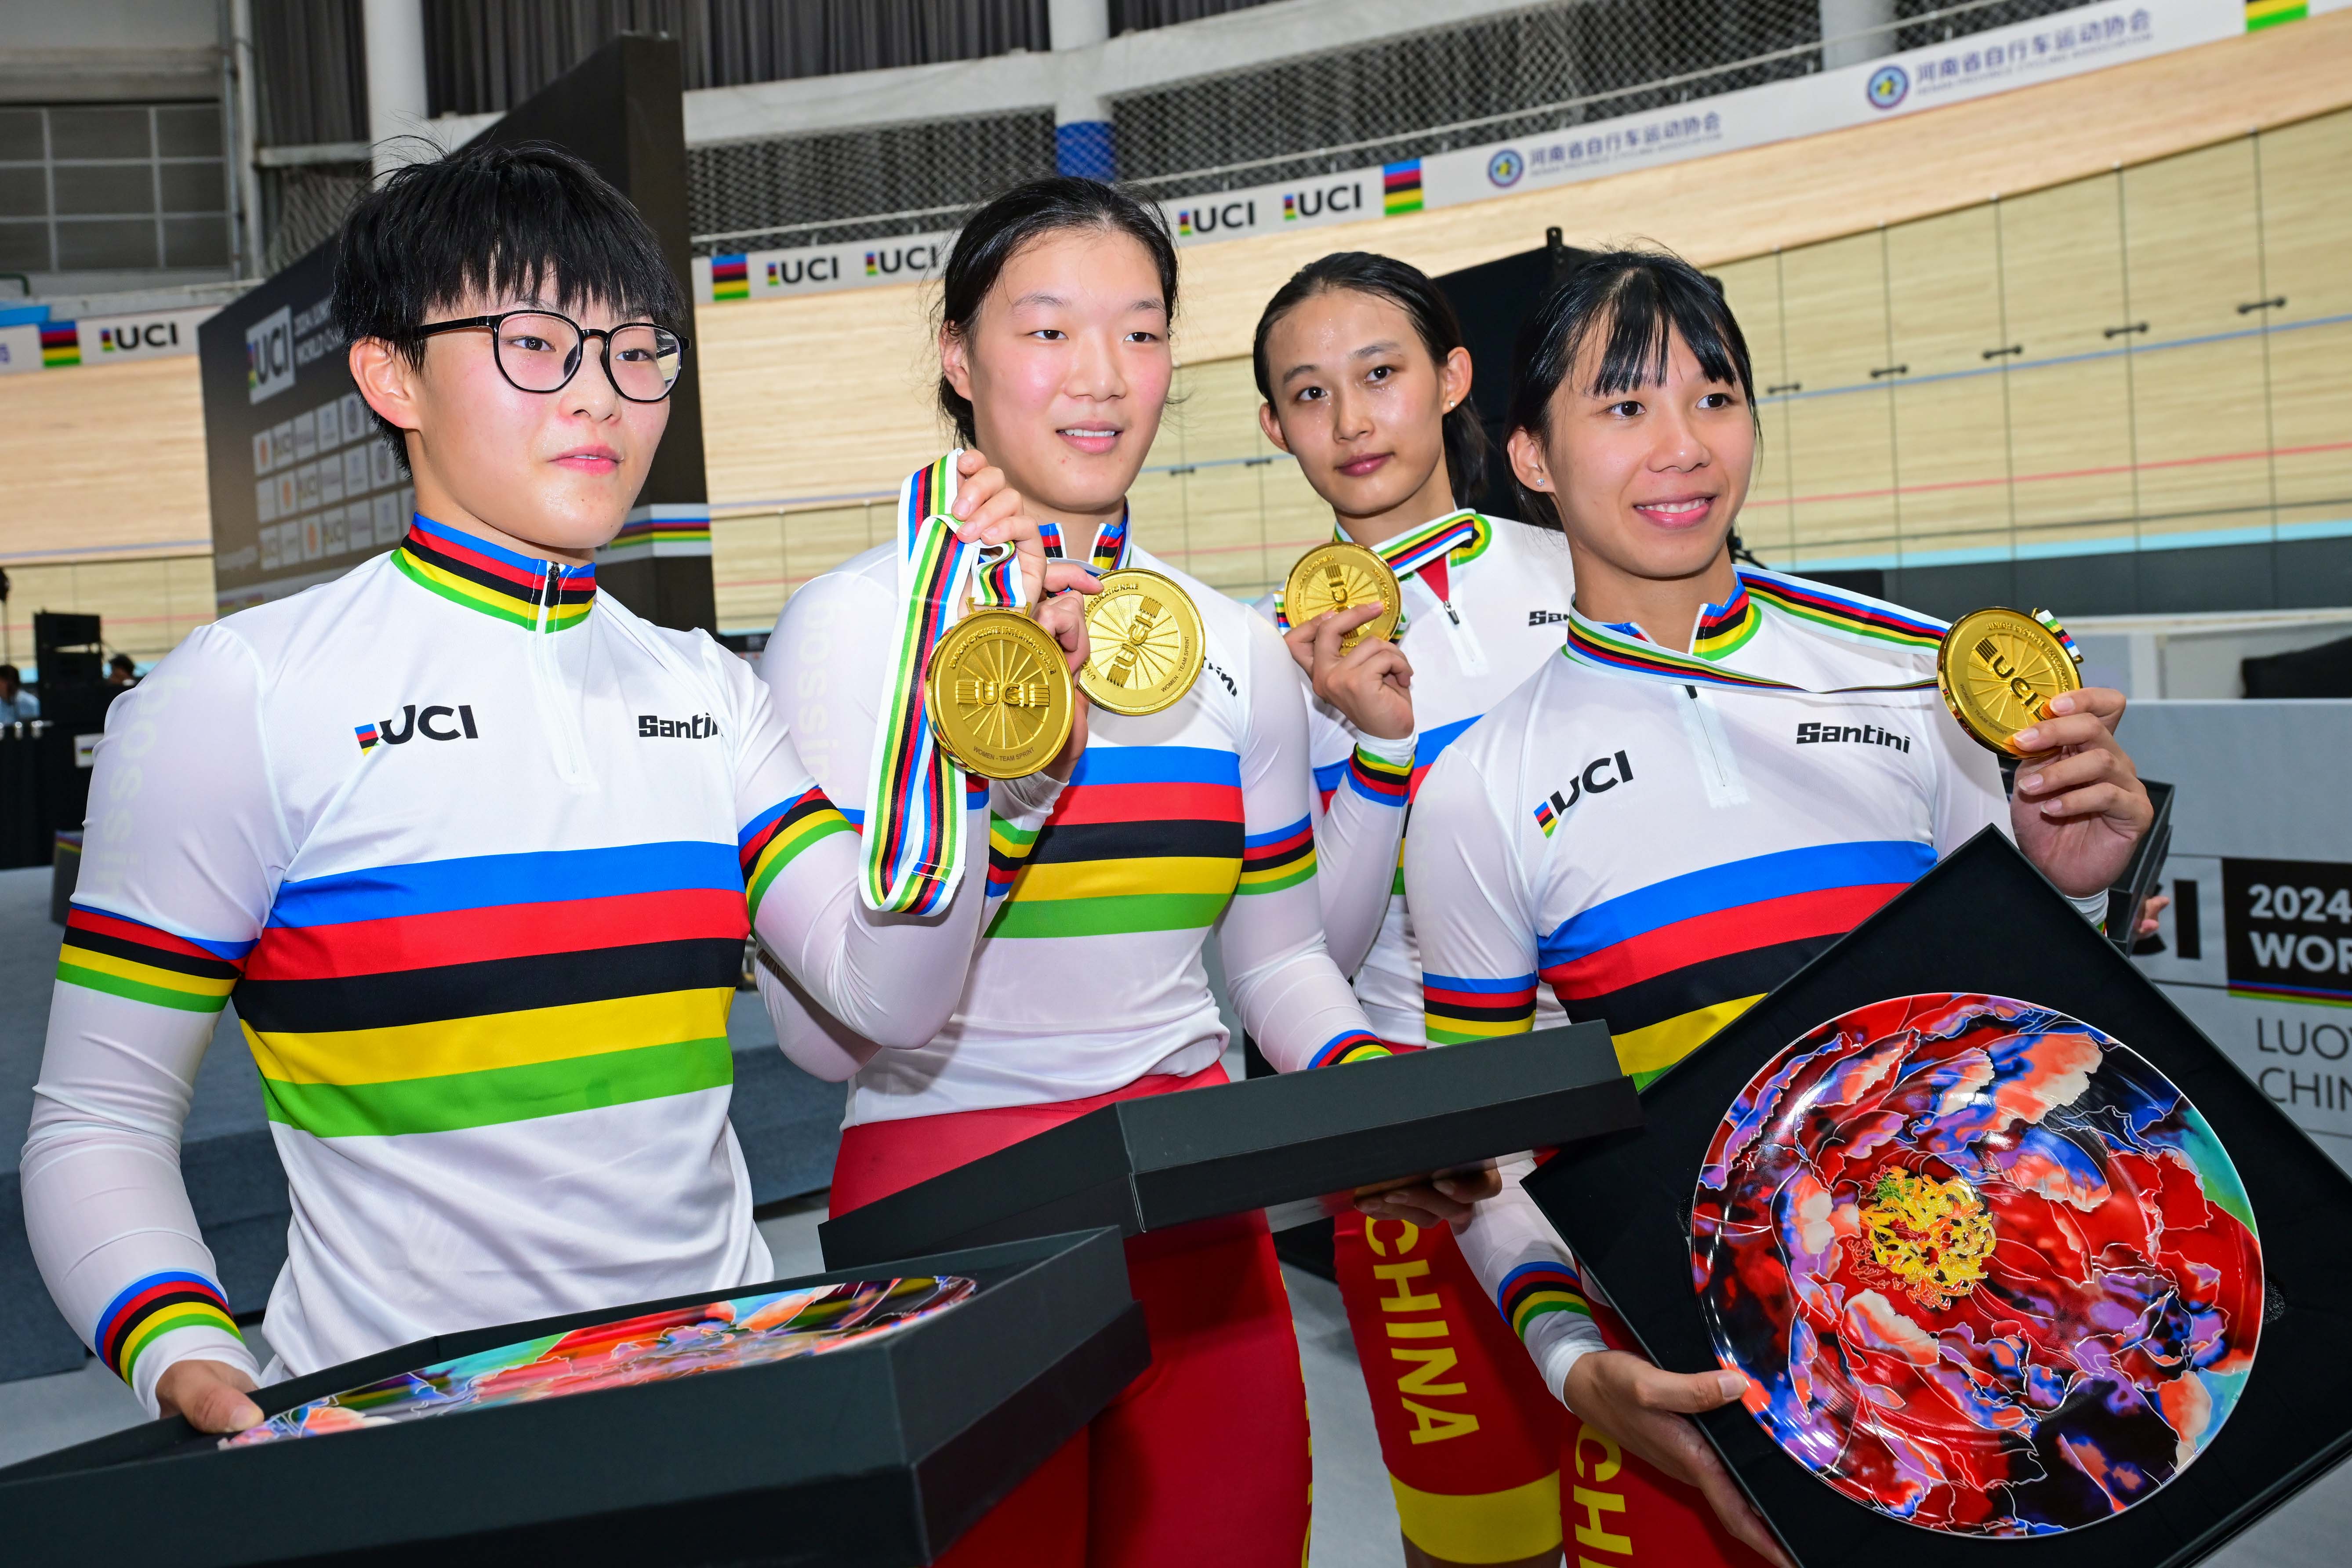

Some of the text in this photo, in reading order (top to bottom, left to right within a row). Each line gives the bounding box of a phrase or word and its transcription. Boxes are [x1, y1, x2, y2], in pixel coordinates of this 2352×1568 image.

[1916, 8, 2151, 83] 河南省自行车运动协会
[1530, 111, 1720, 166] 河南省自行车运动协会
[1193, 200, 1255, 232] UCI
[1299, 183, 1361, 217] UCI
[781, 257, 838, 284] UCI
[879, 246, 937, 273] UCI
[116, 322, 179, 350] UCI
[948, 626, 1056, 675] UNION CYCLISTE INTERNATIONALE
[1114, 615, 1154, 667] UCI
[978, 681, 1030, 707] UCI
[1161, 675, 1179, 693] WOMEN
[1178, 657, 1188, 672] TEAM
[1993, 655, 2039, 707] UCI
[379, 704, 479, 745] UCI
[1960, 683, 1972, 706] WOMEN
[1975, 709, 1989, 724] TEAM
[1989, 722, 2008, 735] SPRINT
[973, 746, 995, 760] WOMEN
[1016, 747, 1034, 760] SPRINT
[1796, 722, 1911, 754] Santini
[1550, 749, 1634, 816] UCI
[2248, 883, 2352, 924] 2024
[2257, 1017, 2352, 1060] LUO
[1365, 1215, 1480, 1445] CHINA
